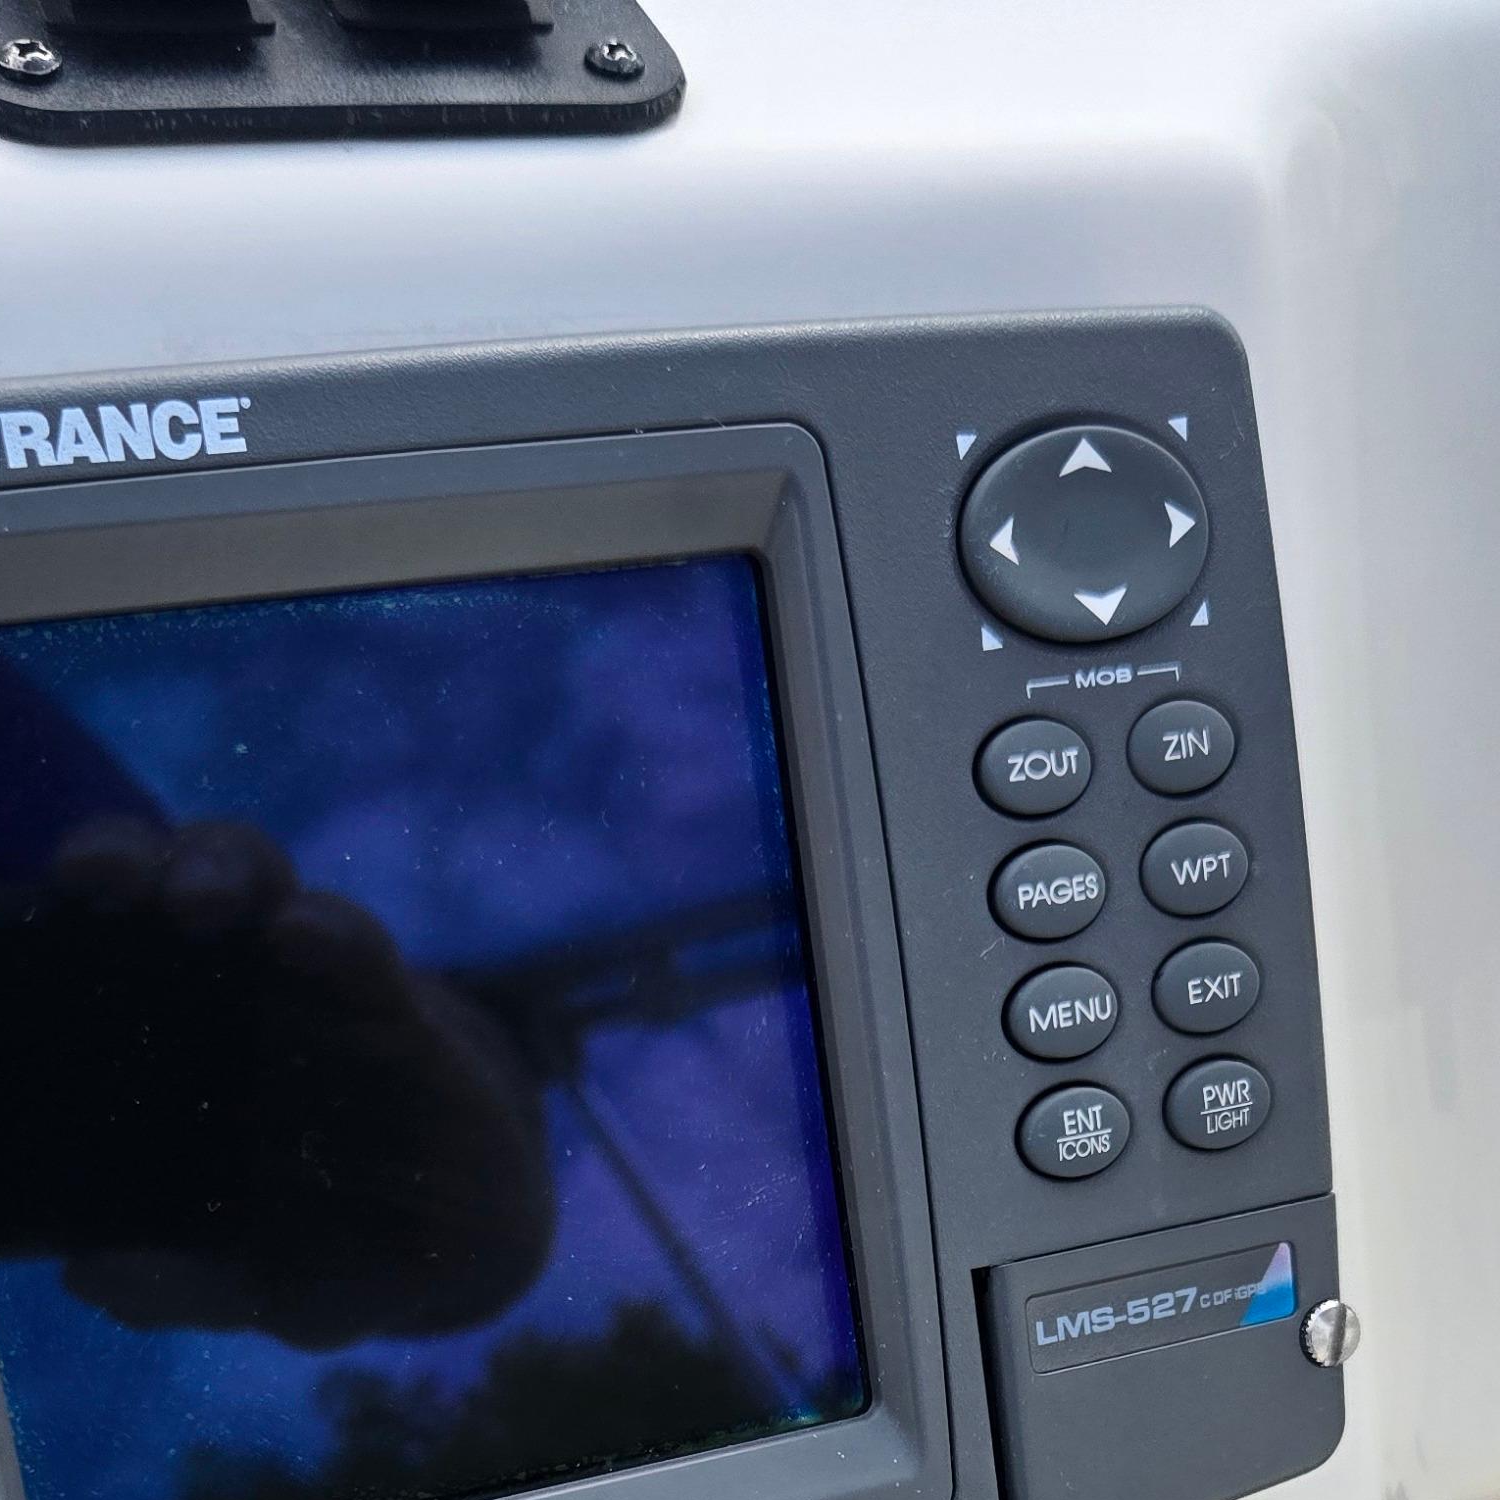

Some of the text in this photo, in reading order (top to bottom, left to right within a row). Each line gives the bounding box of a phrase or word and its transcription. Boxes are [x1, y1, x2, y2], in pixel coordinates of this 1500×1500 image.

[1074, 667, 1134, 689] MOB
[1162, 726, 1211, 762] ZIN
[1007, 749, 1079, 782] ZOUT
[1170, 851, 1232, 887] WPT
[1017, 872, 1100, 911] PAGES
[1186, 972, 1242, 1006] EXIT
[1028, 994, 1113, 1034] MENU
[1202, 1078, 1252, 1110] PWR
[1062, 1104, 1104, 1137] ENT
[1206, 1107, 1251, 1135] LIGHT
[1057, 1134, 1112, 1162] ICONS
[1035, 1286, 1198, 1347] LMS-527
